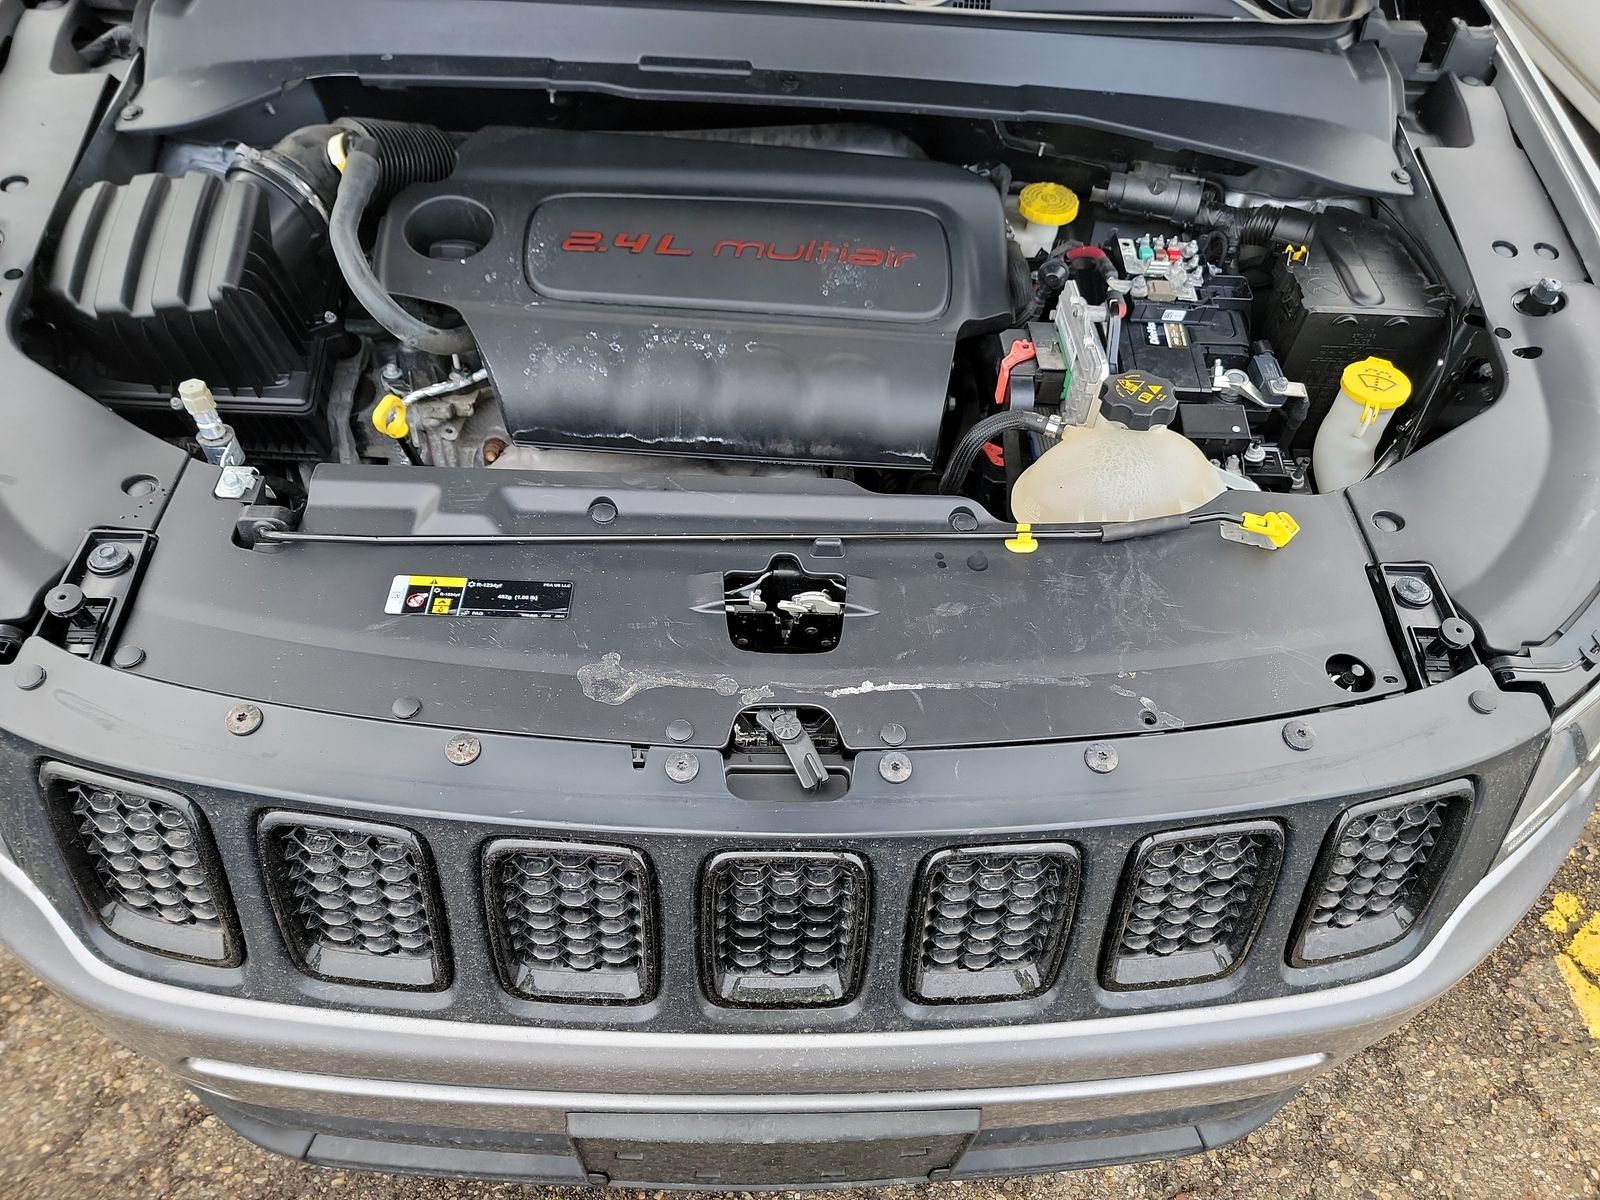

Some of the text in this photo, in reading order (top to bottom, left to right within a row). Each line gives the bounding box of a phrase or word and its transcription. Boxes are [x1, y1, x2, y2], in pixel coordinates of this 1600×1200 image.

[561, 231, 918, 269] 2.4L multiair
[1146, 322, 1160, 345] DieHa
